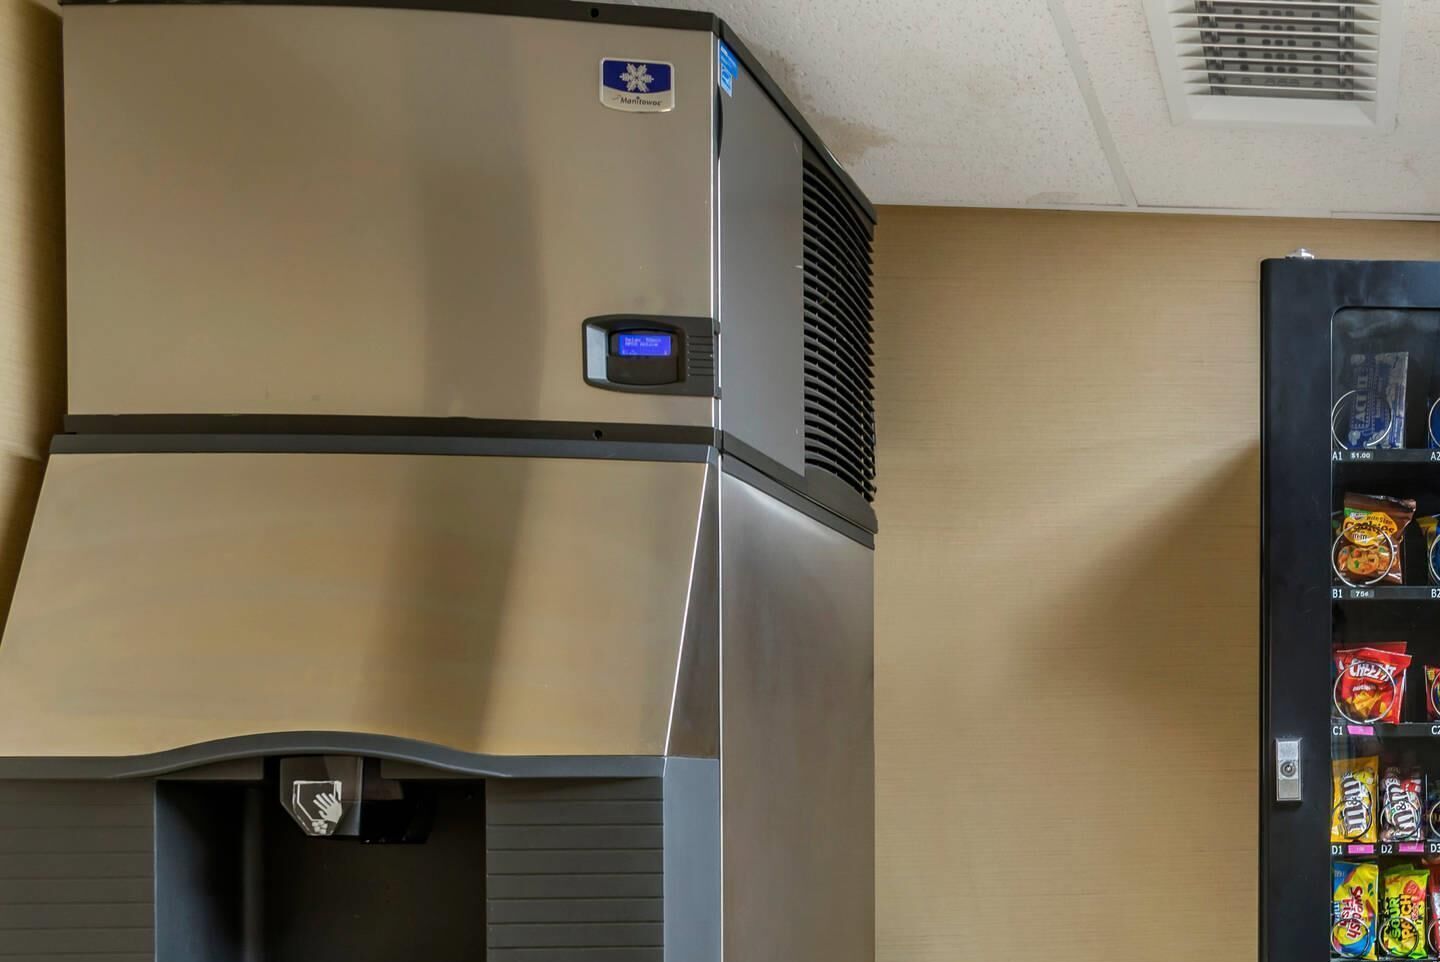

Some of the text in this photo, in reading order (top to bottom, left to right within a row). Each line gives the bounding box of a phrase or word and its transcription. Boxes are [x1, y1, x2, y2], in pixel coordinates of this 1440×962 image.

[620, 96, 662, 107] Manitowoc
[1332, 451, 1343, 461] A1
[1332, 589, 1369, 598] B1 75¢
[1332, 726, 1343, 735] C1
[1331, 845, 1343, 855] D1
[1381, 843, 1392, 854] D2
[1347, 886, 1365, 939] Swedish
[1391, 896, 1401, 938] SOUR
